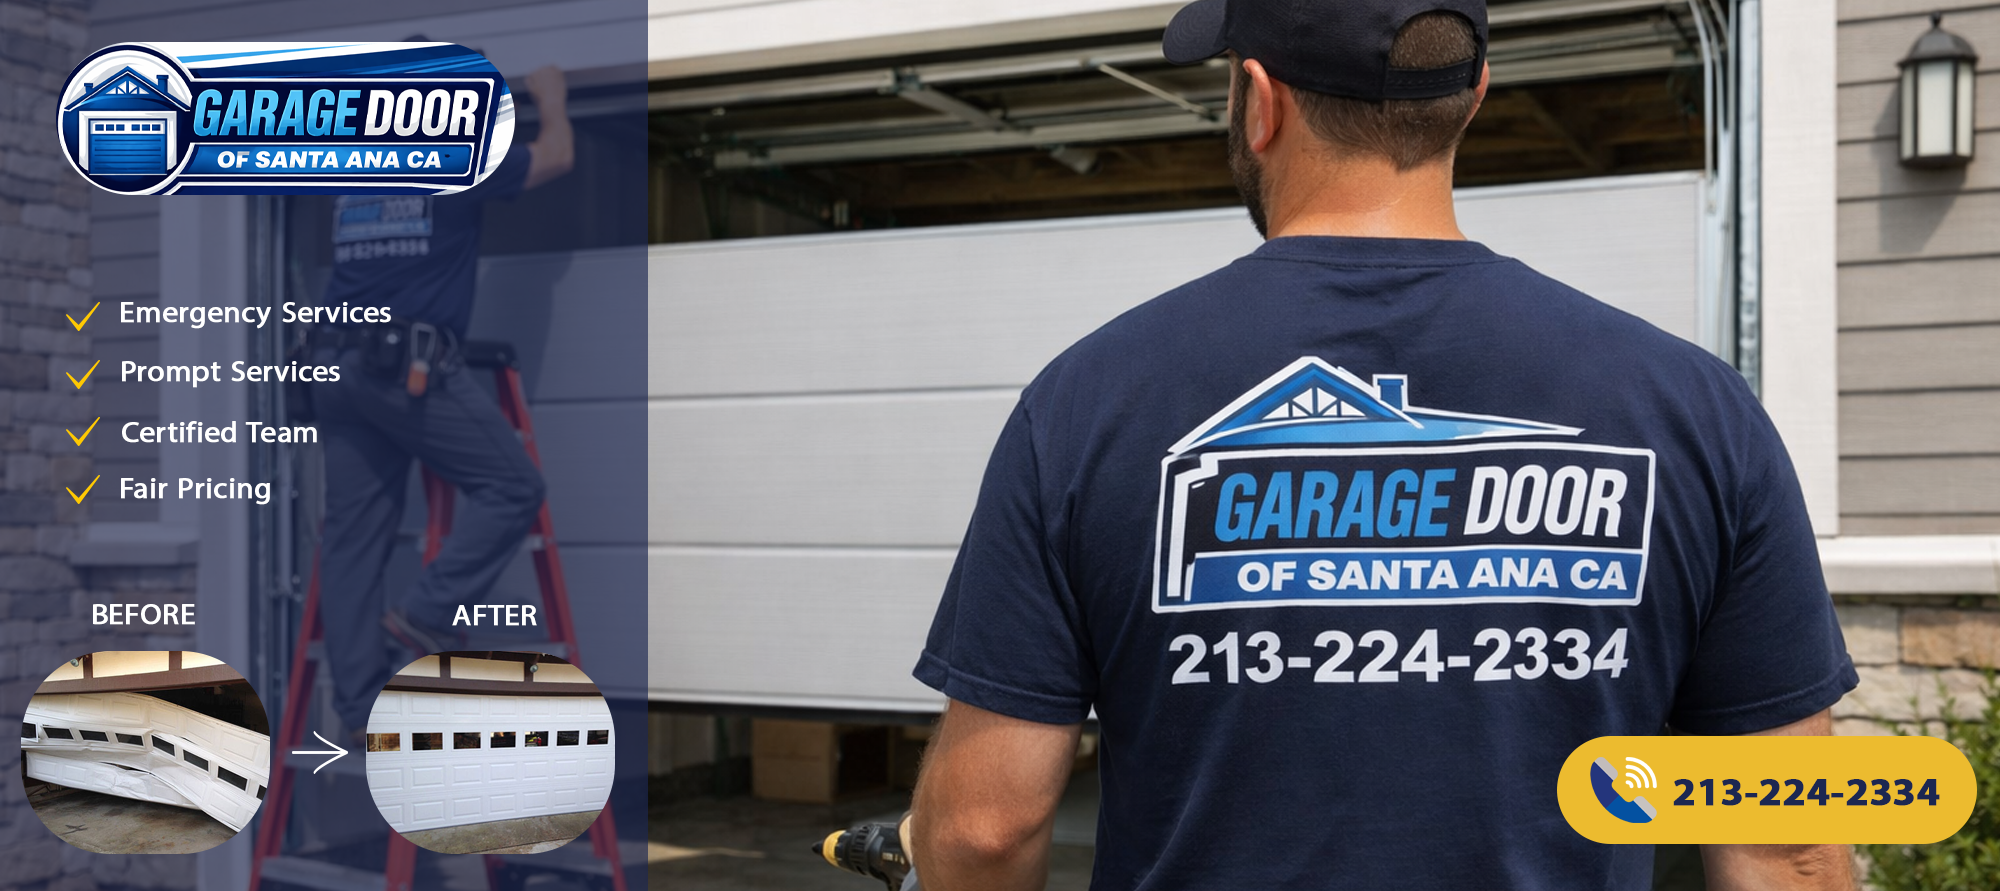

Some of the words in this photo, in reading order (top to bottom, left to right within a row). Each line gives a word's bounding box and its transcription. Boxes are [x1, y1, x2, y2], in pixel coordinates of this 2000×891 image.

[1214, 468, 1457, 542] GARAGE
[1464, 464, 1628, 537] DOOR
[1237, 561, 1297, 591] OF
[1307, 559, 1460, 591] SANTA
[1467, 557, 1559, 589] ANA
[1570, 560, 1628, 591] CA
[1168, 627, 1629, 685] 213-224-2334
